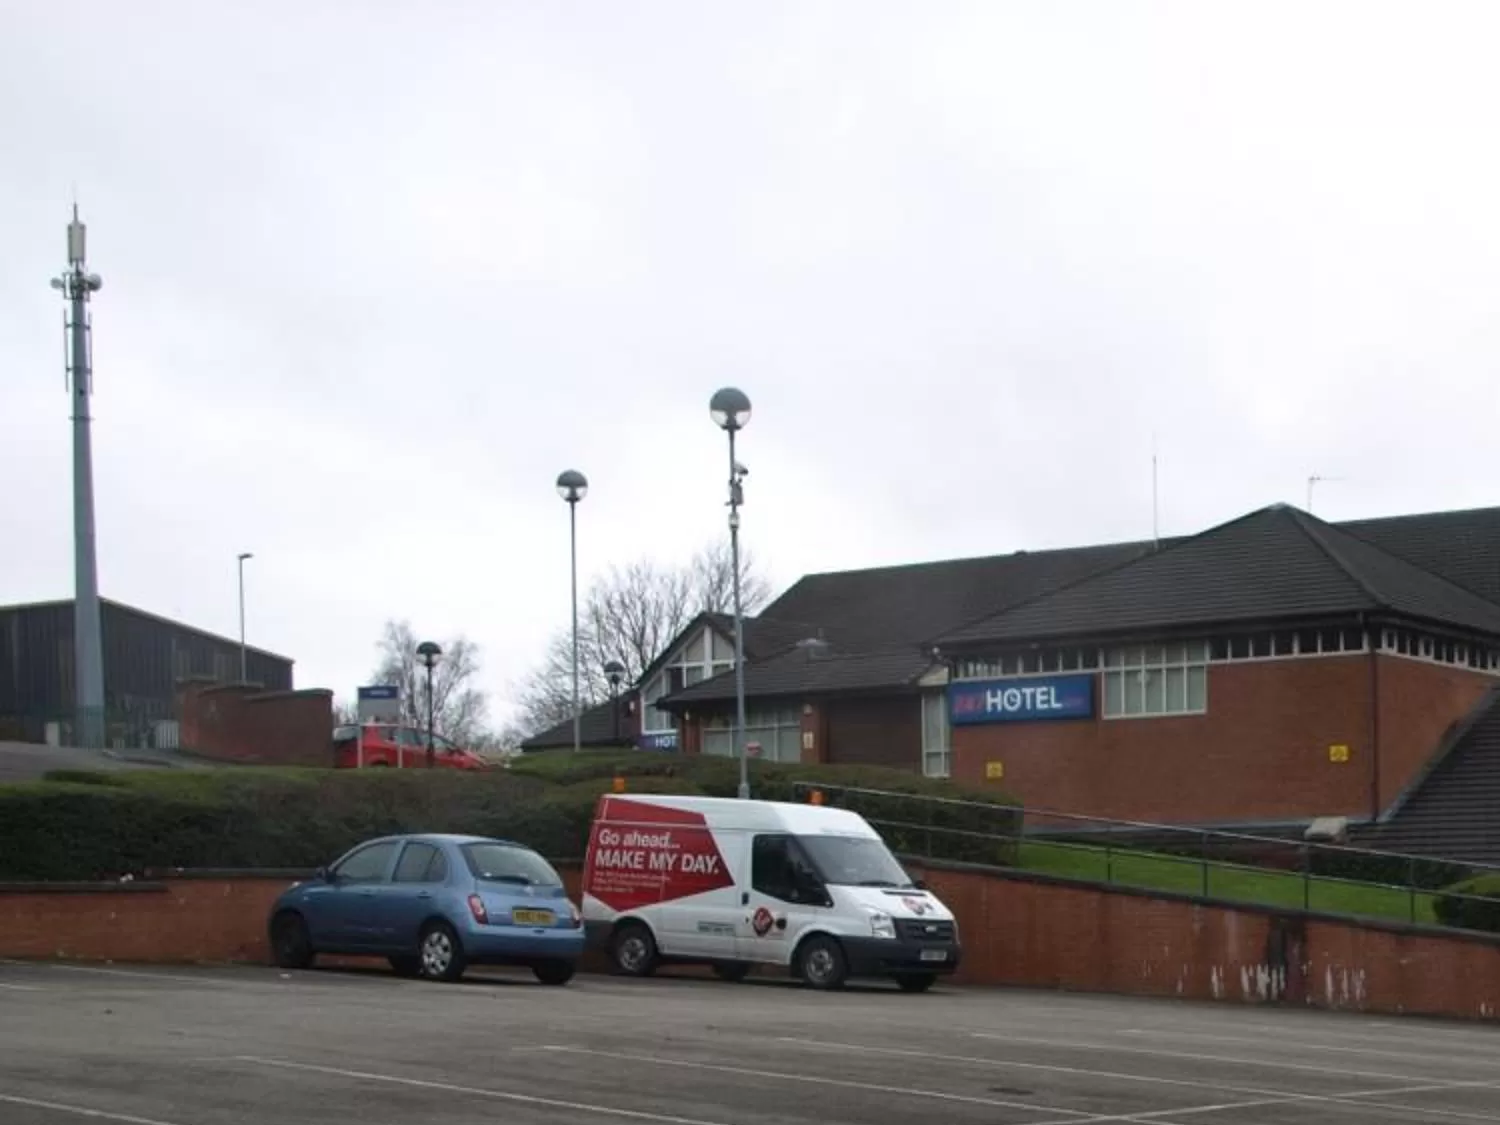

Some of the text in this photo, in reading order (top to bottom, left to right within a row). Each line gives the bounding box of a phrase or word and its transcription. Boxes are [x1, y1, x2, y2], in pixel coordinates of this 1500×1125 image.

[986, 686, 1062, 712] HOTEL
[599, 829, 681, 849] Go ahead...
[595, 850, 719, 875] MAKE MY DAY.
